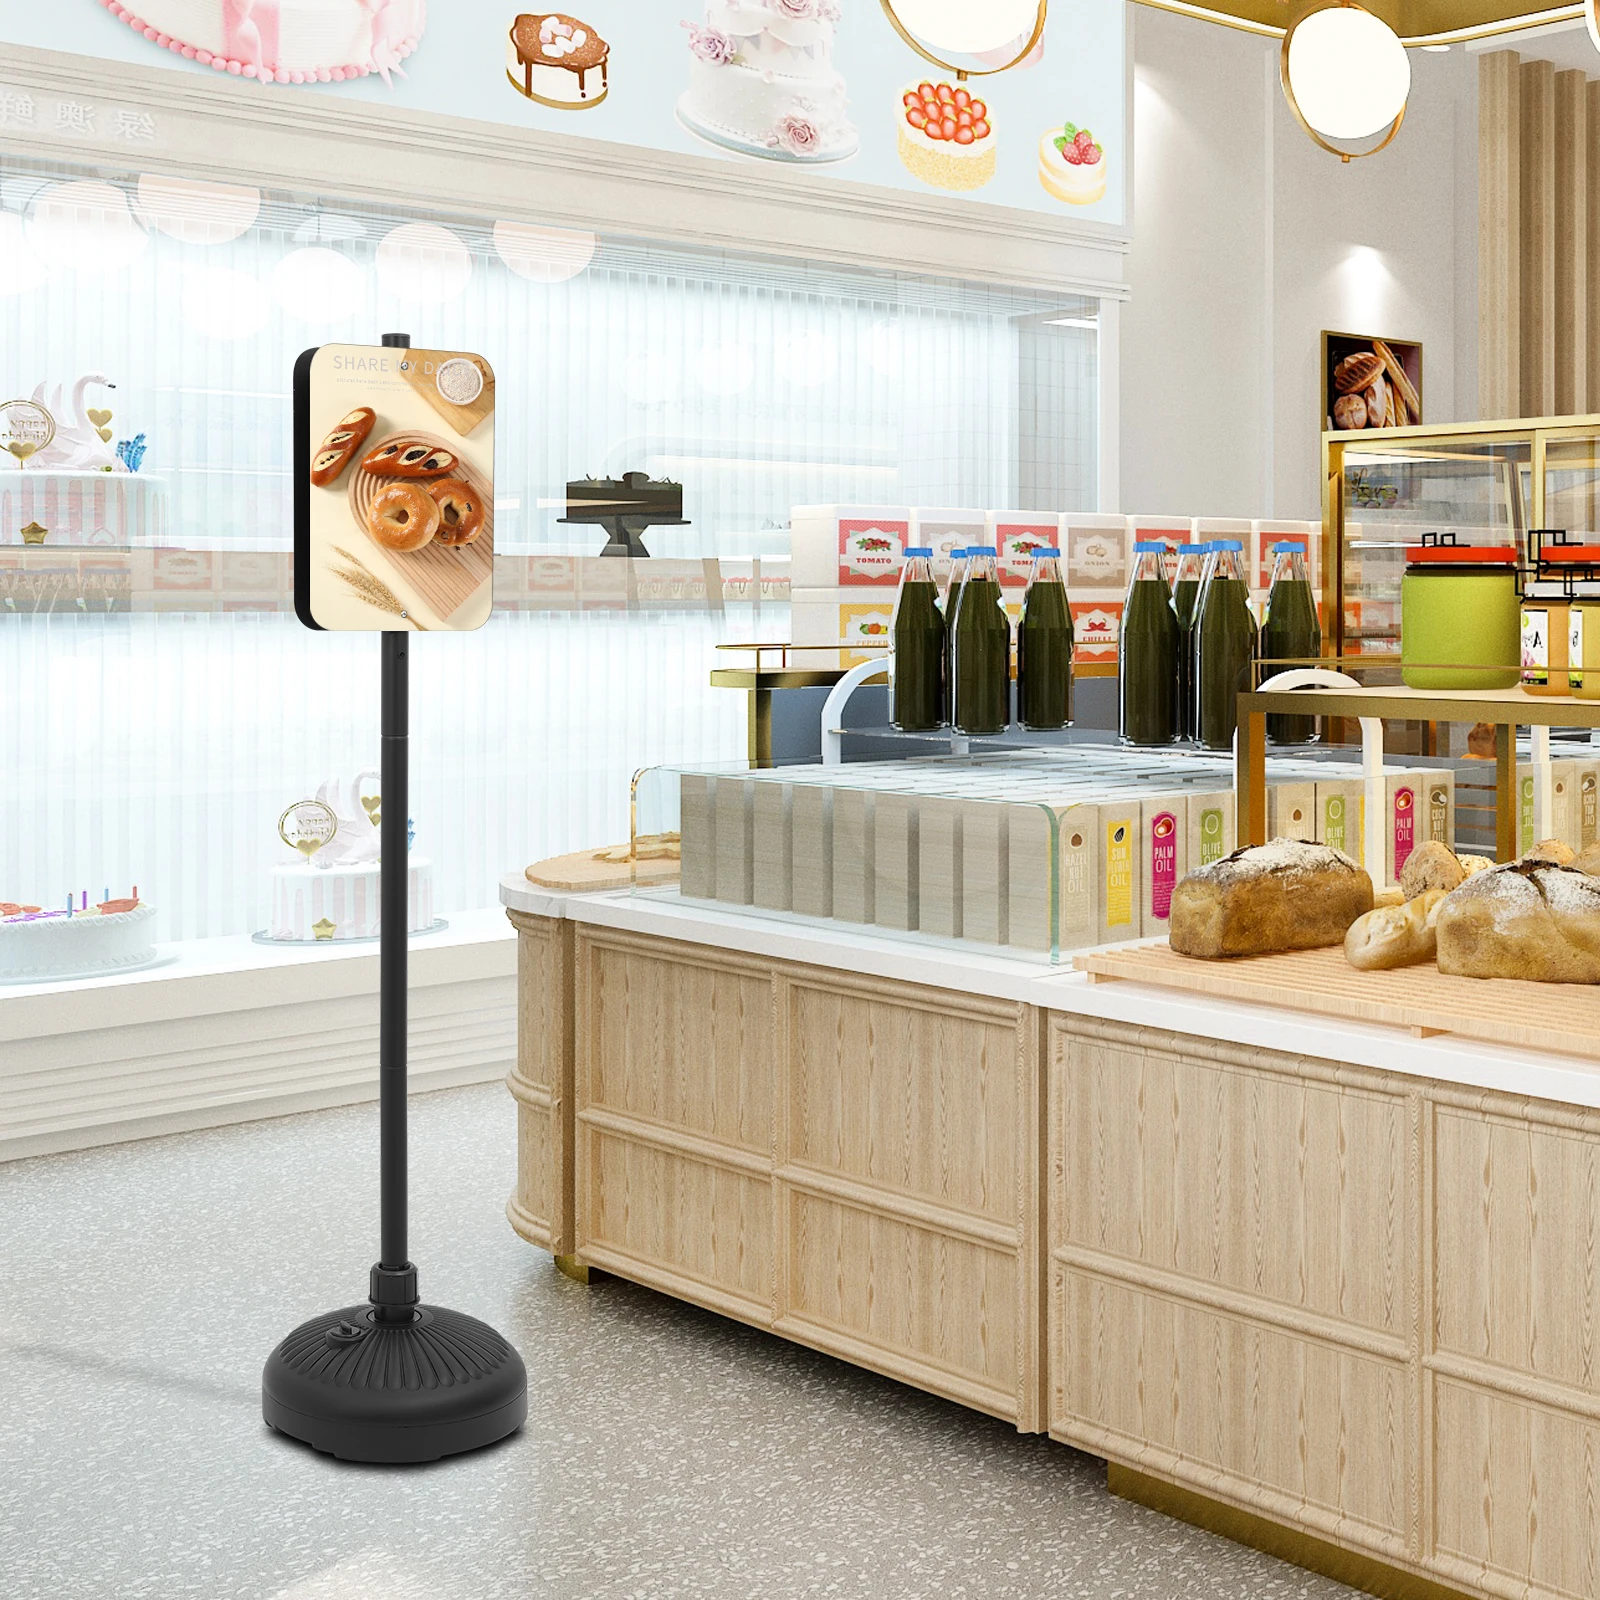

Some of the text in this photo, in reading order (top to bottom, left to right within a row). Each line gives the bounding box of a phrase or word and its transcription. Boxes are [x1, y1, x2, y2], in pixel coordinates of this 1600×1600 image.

[333, 355, 389, 373] SHARE
[1396, 817, 1412, 829] PALM
[1397, 829, 1411, 842] OIL
[1111, 847, 1127, 861] SUN
[1154, 845, 1174, 860] PALM
[1202, 842, 1221, 856] OLIVE
[1155, 859, 1173, 873] OIL
[1110, 872, 1128, 887] OIL
[1068, 880, 1085, 894] OIL
